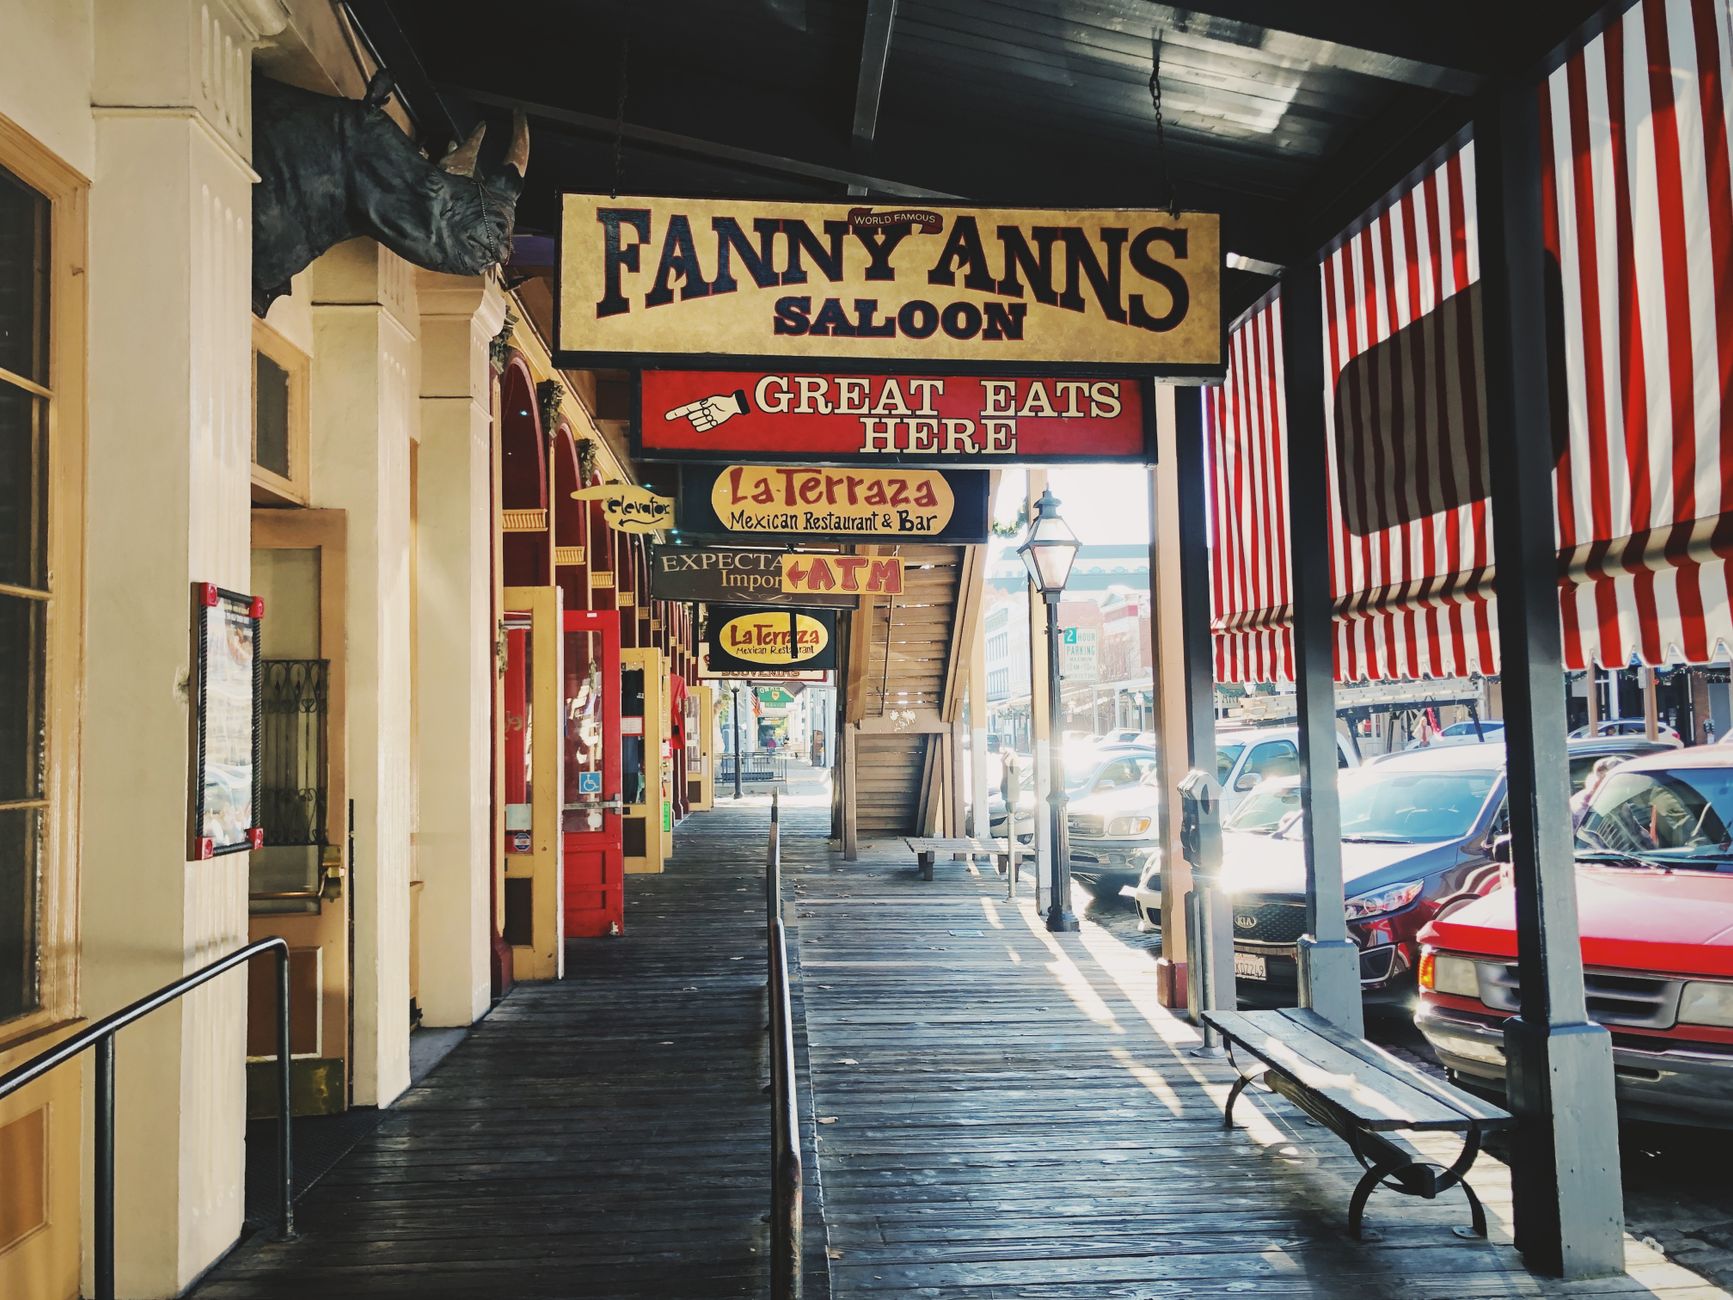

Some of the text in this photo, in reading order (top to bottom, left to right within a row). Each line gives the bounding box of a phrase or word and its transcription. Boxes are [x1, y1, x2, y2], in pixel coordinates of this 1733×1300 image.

[854, 213, 936, 225] WORLD FAMOUS
[596, 207, 1190, 333] FANNY ANNS
[773, 296, 1027, 341] SALOON
[754, 376, 1122, 419] GREAT EATS
[858, 416, 1018, 455] HERE
[729, 467, 939, 508] La Terraza
[606, 495, 670, 516] elevator
[730, 510, 938, 532] Mexican Restaurant & Bar
[807, 557, 902, 593] ATM
[730, 624, 752, 647] La
[1066, 629, 1074, 642] 2
[735, 645, 767, 655] Mexican
[1066, 645, 1095, 655] PARKING
[1237, 916, 1253, 926] KIA
